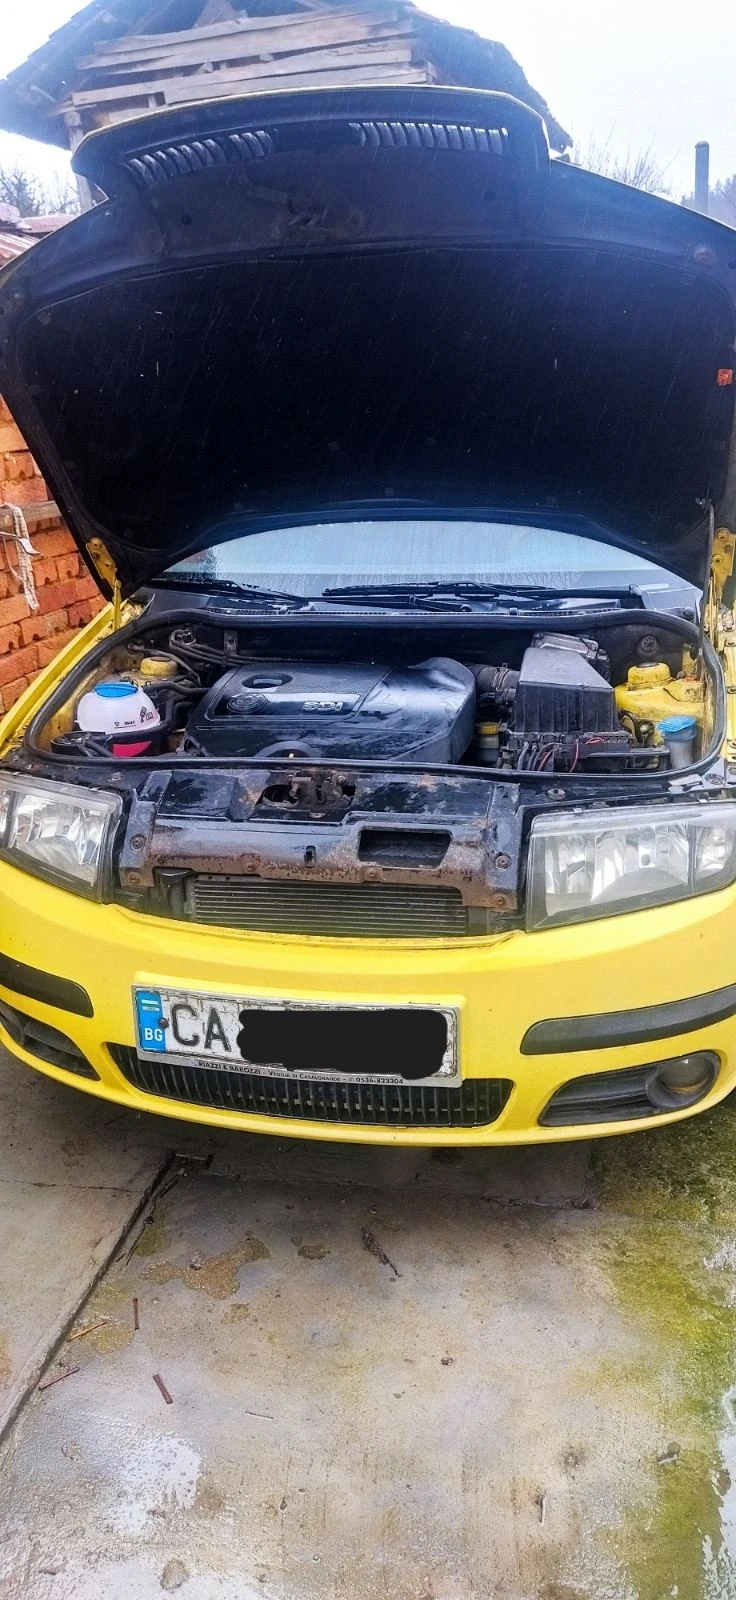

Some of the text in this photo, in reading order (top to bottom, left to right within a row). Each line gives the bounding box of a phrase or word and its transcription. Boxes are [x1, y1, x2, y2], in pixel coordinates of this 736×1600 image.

[303, 702, 343, 712] SDI
[144, 1027, 163, 1041] BG
[171, 1004, 231, 1053] CA
